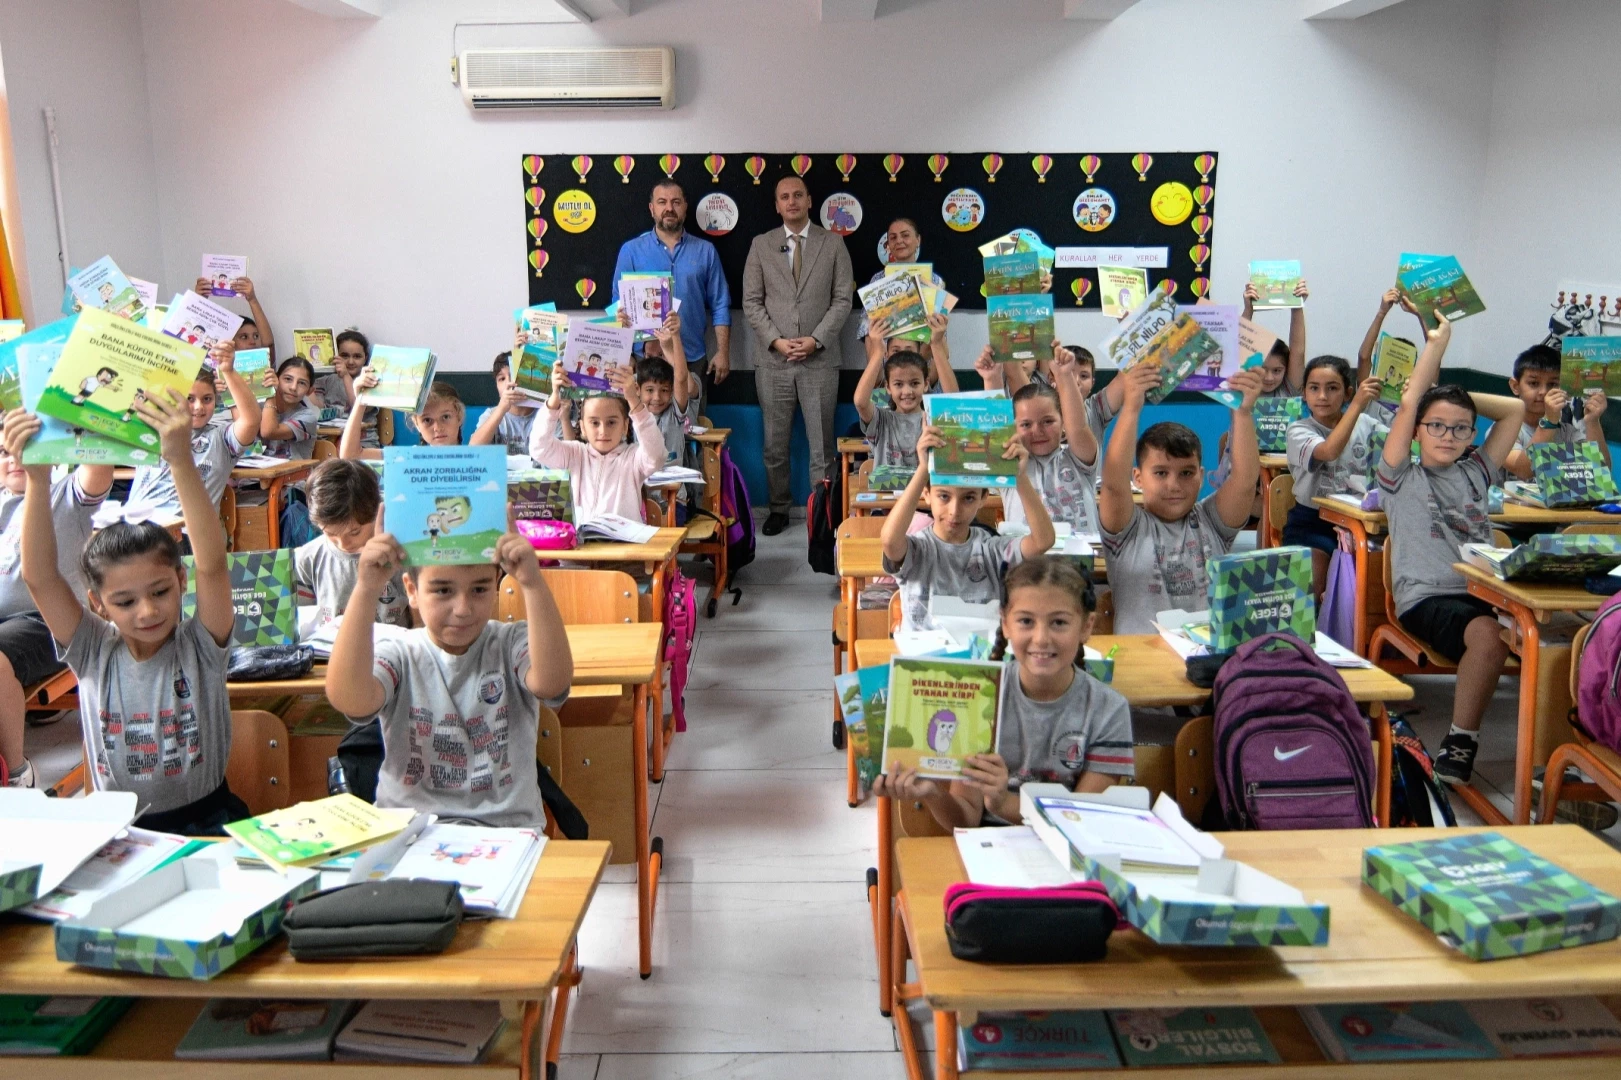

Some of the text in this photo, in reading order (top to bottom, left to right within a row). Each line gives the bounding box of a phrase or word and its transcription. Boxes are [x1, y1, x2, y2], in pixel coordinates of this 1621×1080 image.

[558, 202, 592, 211] MUTLU OL
[1025, 306, 1050, 316] AĞACI
[1138, 313, 1166, 342] NİLPO
[101, 333, 125, 347] BANA
[127, 341, 155, 358] KÜFÜR
[155, 352, 177, 366] ETME
[1600, 347, 1621, 357] AĞAC
[89, 337, 146, 364] DUYGULARIMI
[147, 358, 179, 376] İNCİTME
[937, 411, 1008, 424] ZEYTİN AĞACI
[434, 466, 488, 474] ZORBALIĞINA
[430, 474, 481, 483] DİYEBİLİRSİN
[1244, 597, 1261, 606] VAKFI
[1262, 595, 1283, 604] EĞİTİM
[1250, 607, 1277, 620] EGEV
[912, 678, 980, 690] DİKENLERİNDEN
[913, 689, 975, 699] UTANAN KİRPİ
[1195, 918, 1227, 928] Okumak
[1014, 1023, 1093, 1044] TÜRKÇE
[1157, 1028, 1254, 1044] BİLGİLER
[1176, 1041, 1262, 1057] SOSYAL
